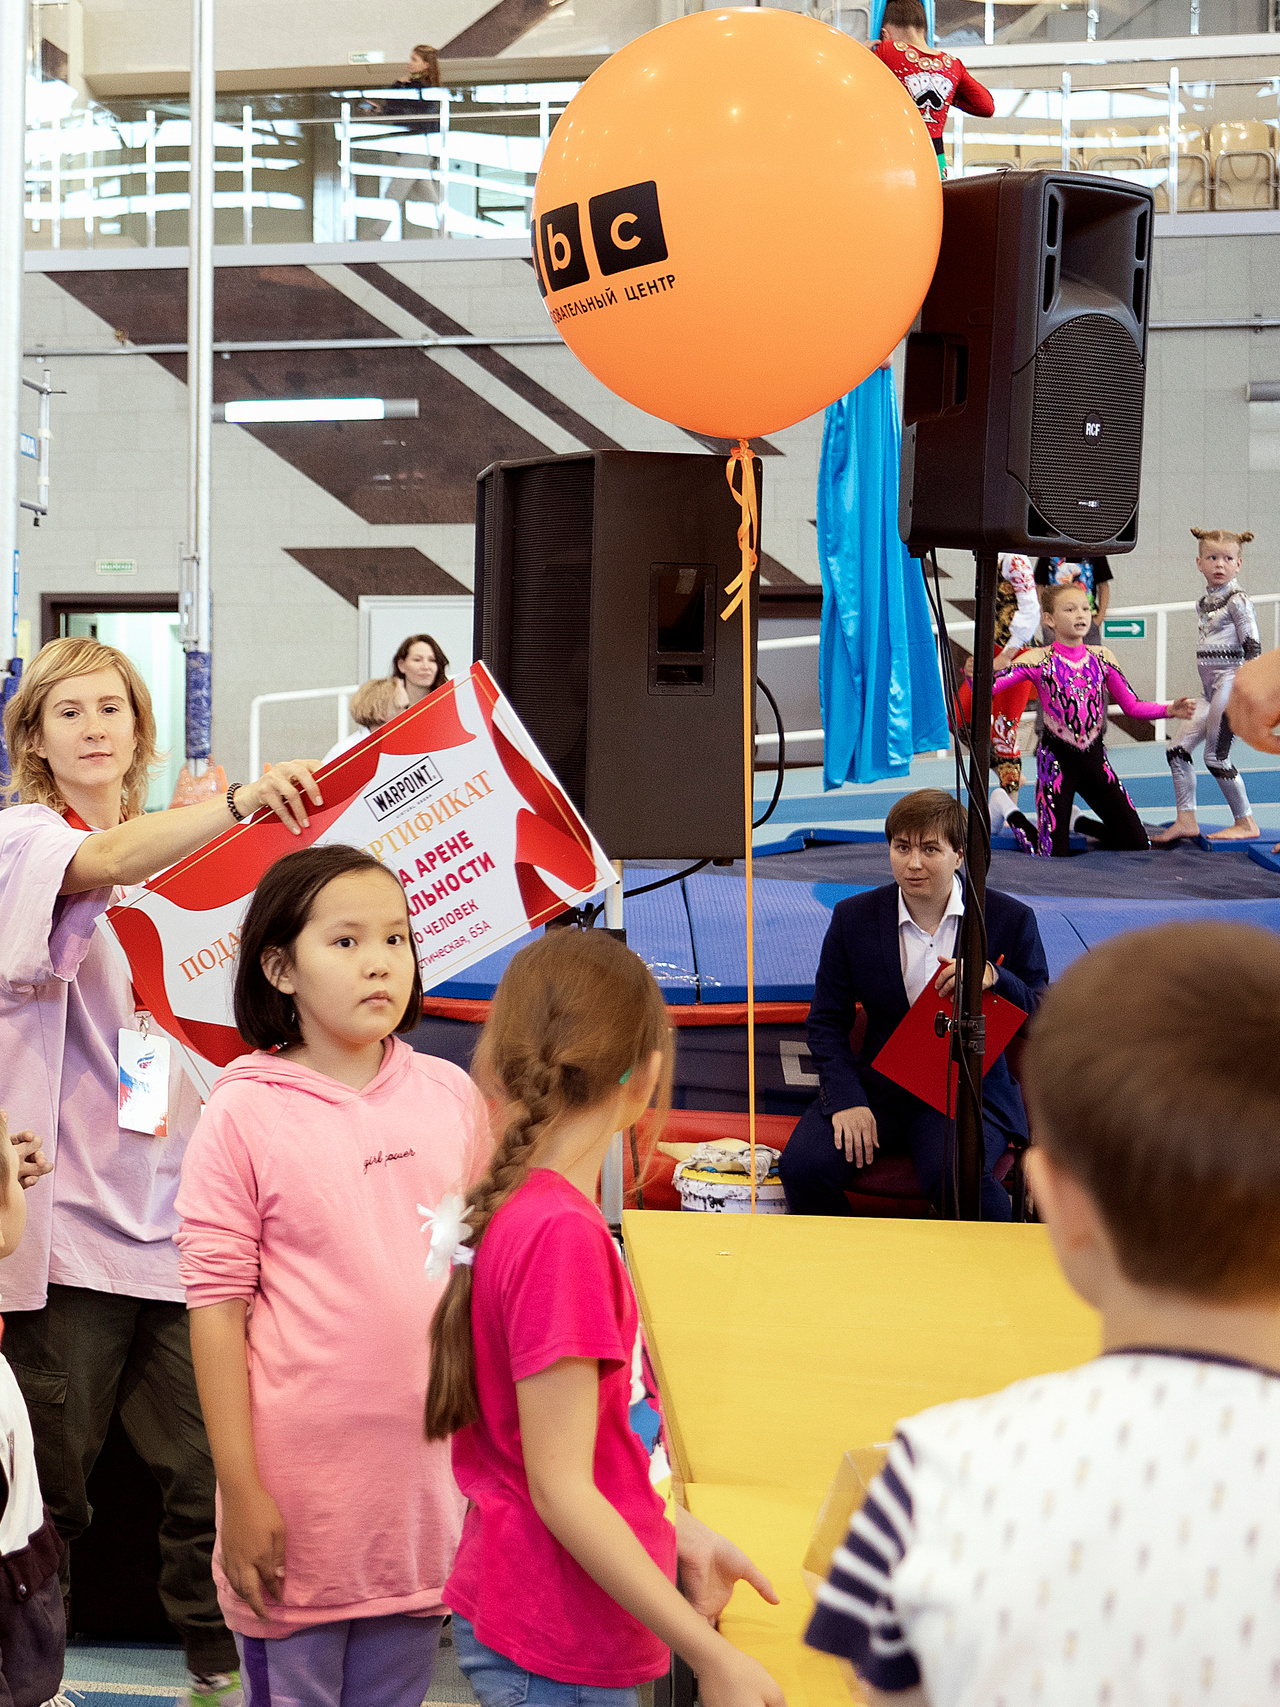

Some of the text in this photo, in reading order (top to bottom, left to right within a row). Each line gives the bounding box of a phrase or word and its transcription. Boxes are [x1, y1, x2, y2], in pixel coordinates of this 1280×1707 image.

[550, 274, 676, 324] ОВАТЕЛЬНЫЙ ЦЕНТР
[1086, 423, 1100, 436] RCF
[373, 765, 433, 812] WARPOINT
[361, 770, 495, 862] РТИФИКАТ
[398, 830, 474, 888] А АРЕНЕ
[423, 898, 480, 936] ЧЕЛОВЕК
[178, 926, 243, 982] ПОДА
[418, 935, 471, 969] стическая,
[363, 1150, 383, 1175] girl
